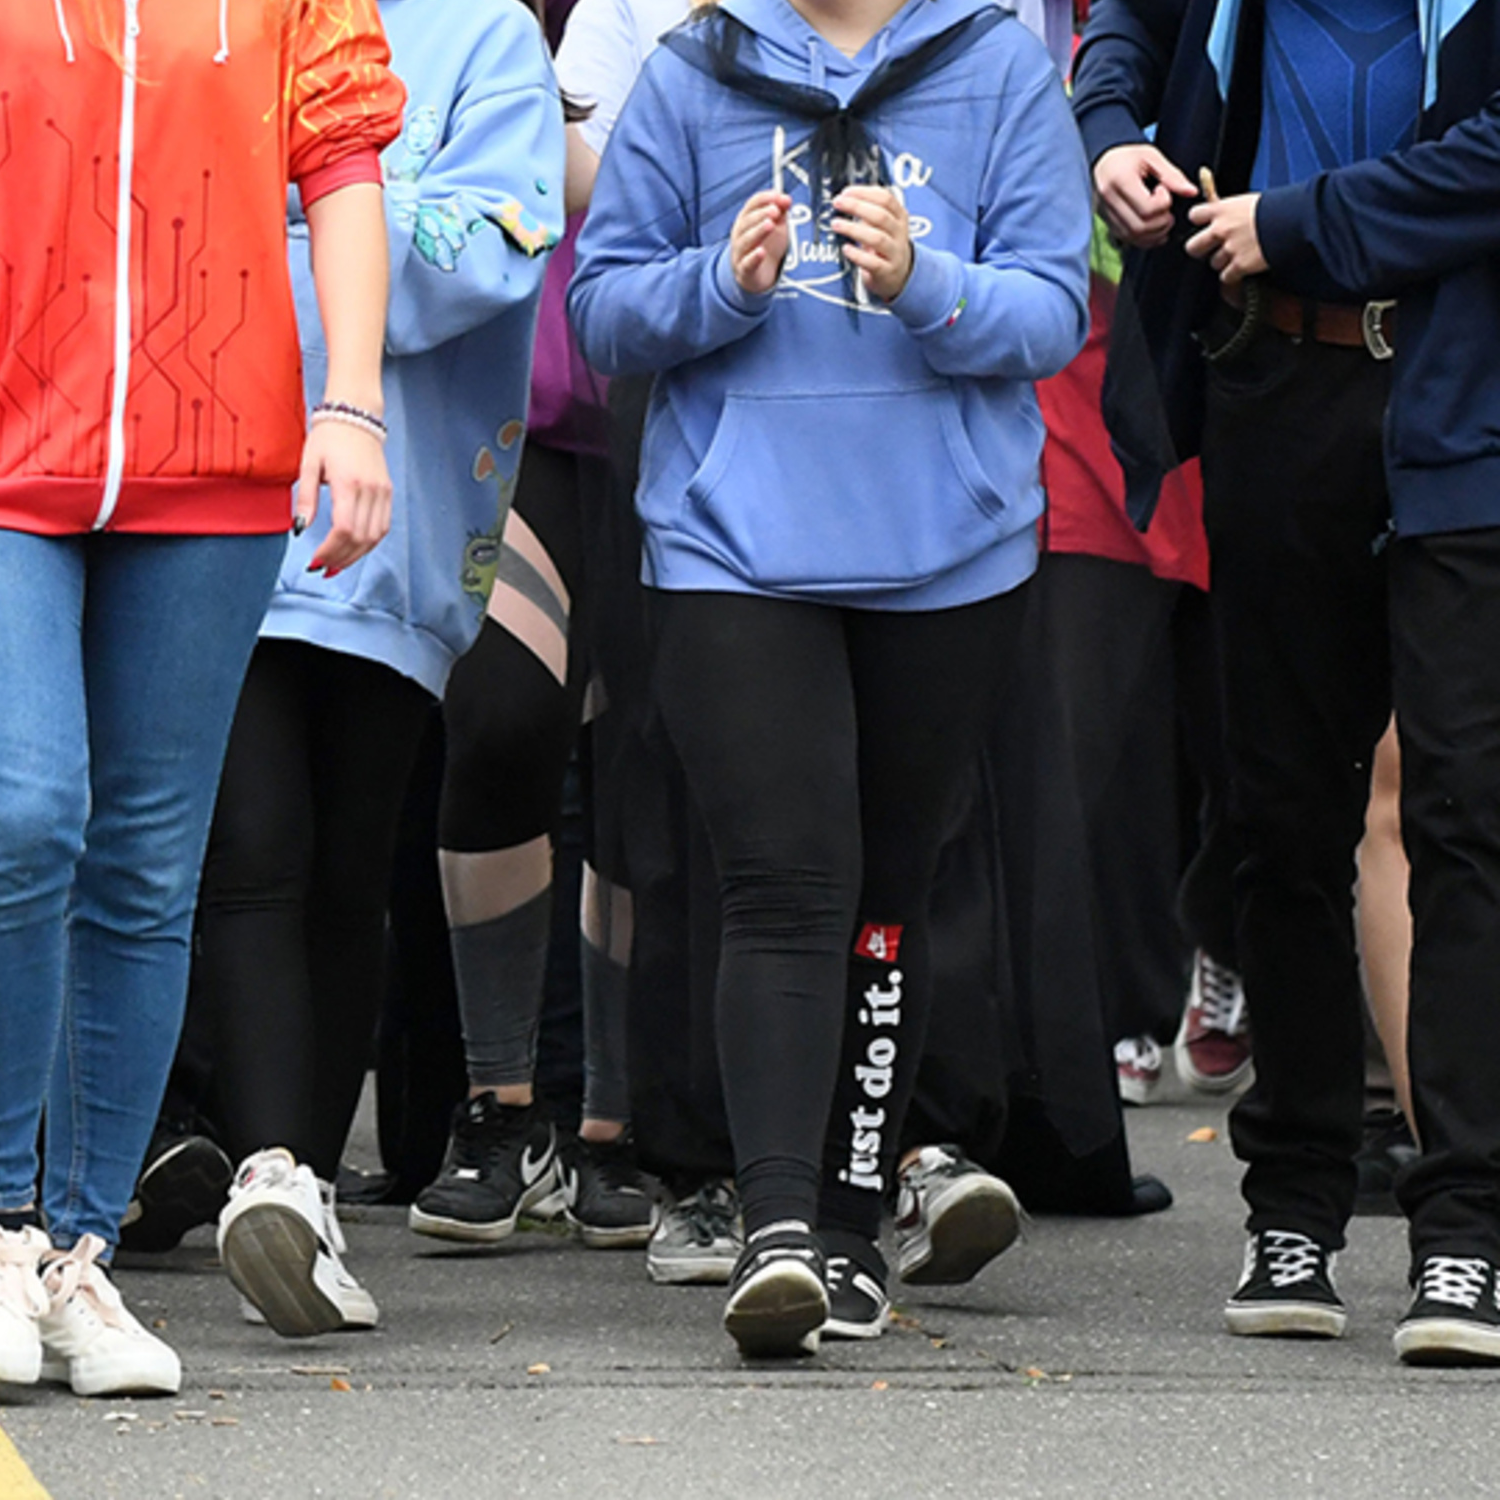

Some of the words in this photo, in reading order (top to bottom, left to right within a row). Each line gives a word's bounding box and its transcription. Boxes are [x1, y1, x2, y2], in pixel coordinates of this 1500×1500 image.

[858, 969, 903, 1026] it.
[854, 1037, 897, 1098] do
[838, 1104, 886, 1192] just
